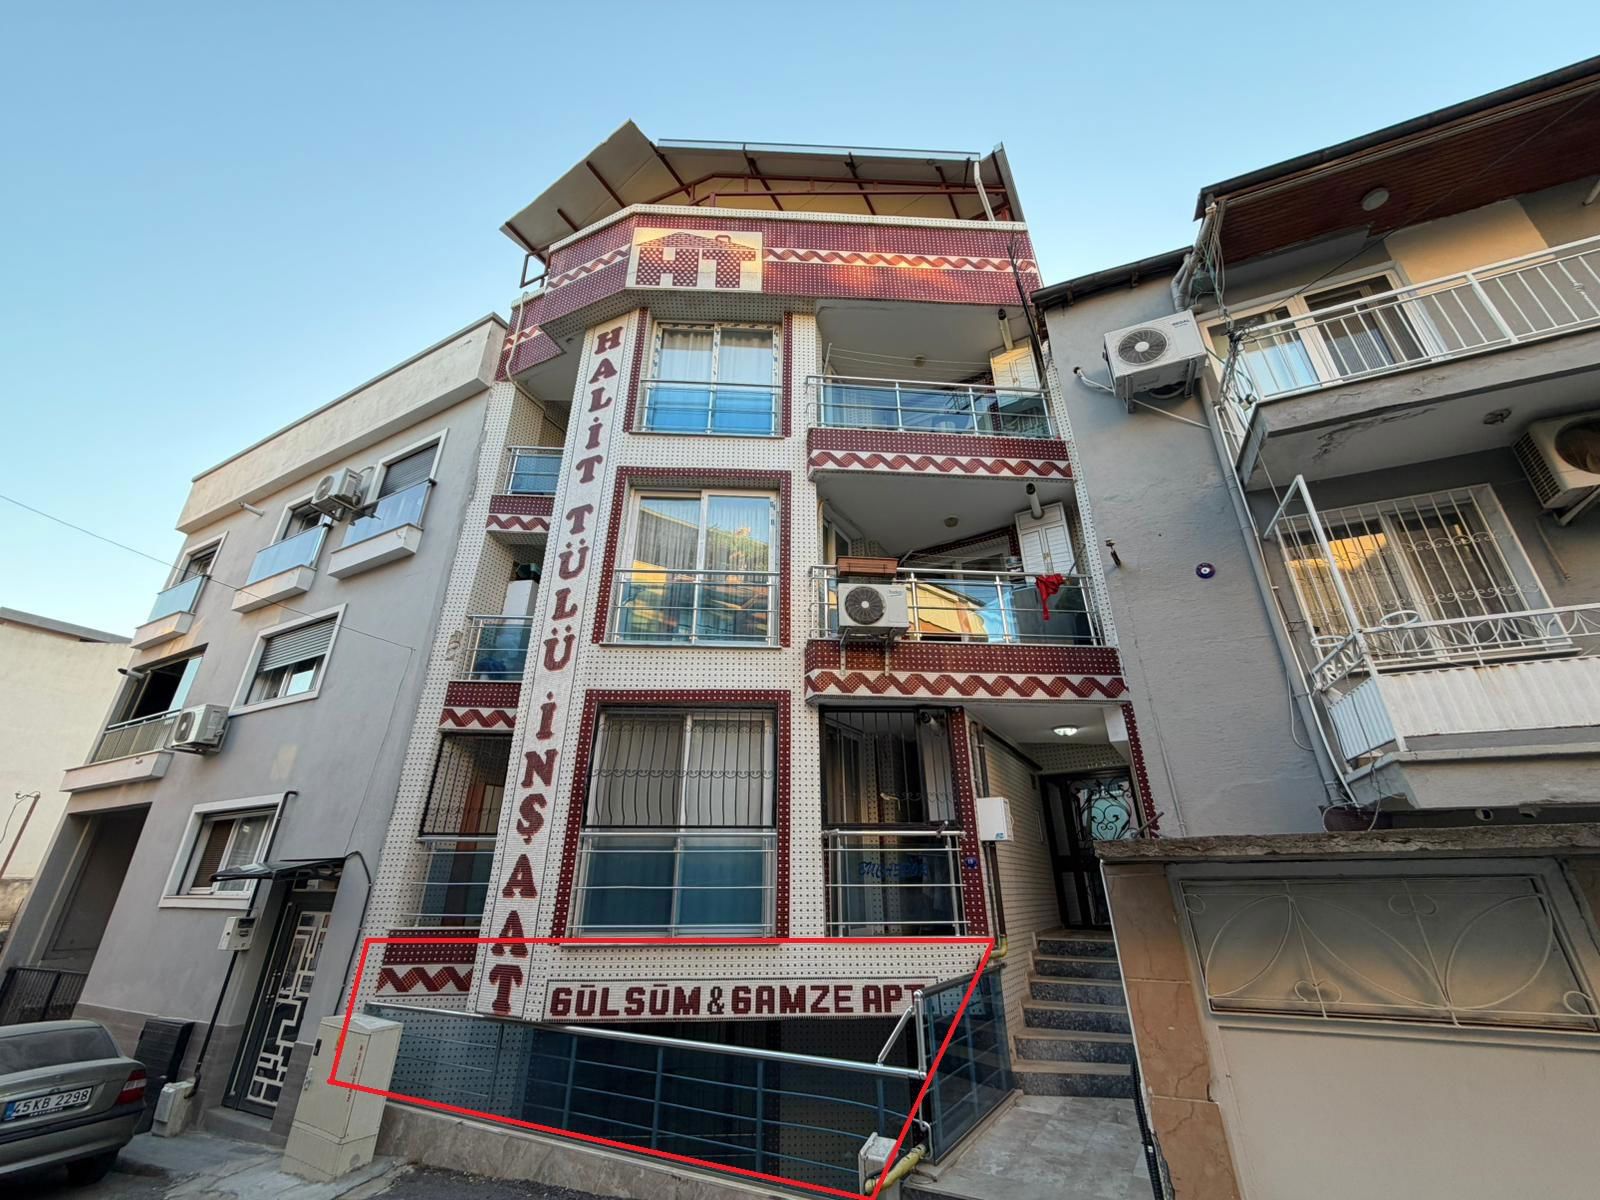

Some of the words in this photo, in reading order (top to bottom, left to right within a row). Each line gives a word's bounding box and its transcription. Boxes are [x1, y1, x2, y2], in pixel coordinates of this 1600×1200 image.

[635, 248, 756, 288] HT
[576, 326, 624, 484] HALİT
[543, 504, 594, 672] TÜLÜ
[488, 691, 559, 1016] İNŞAAT
[731, 985, 854, 1014] GAMZE
